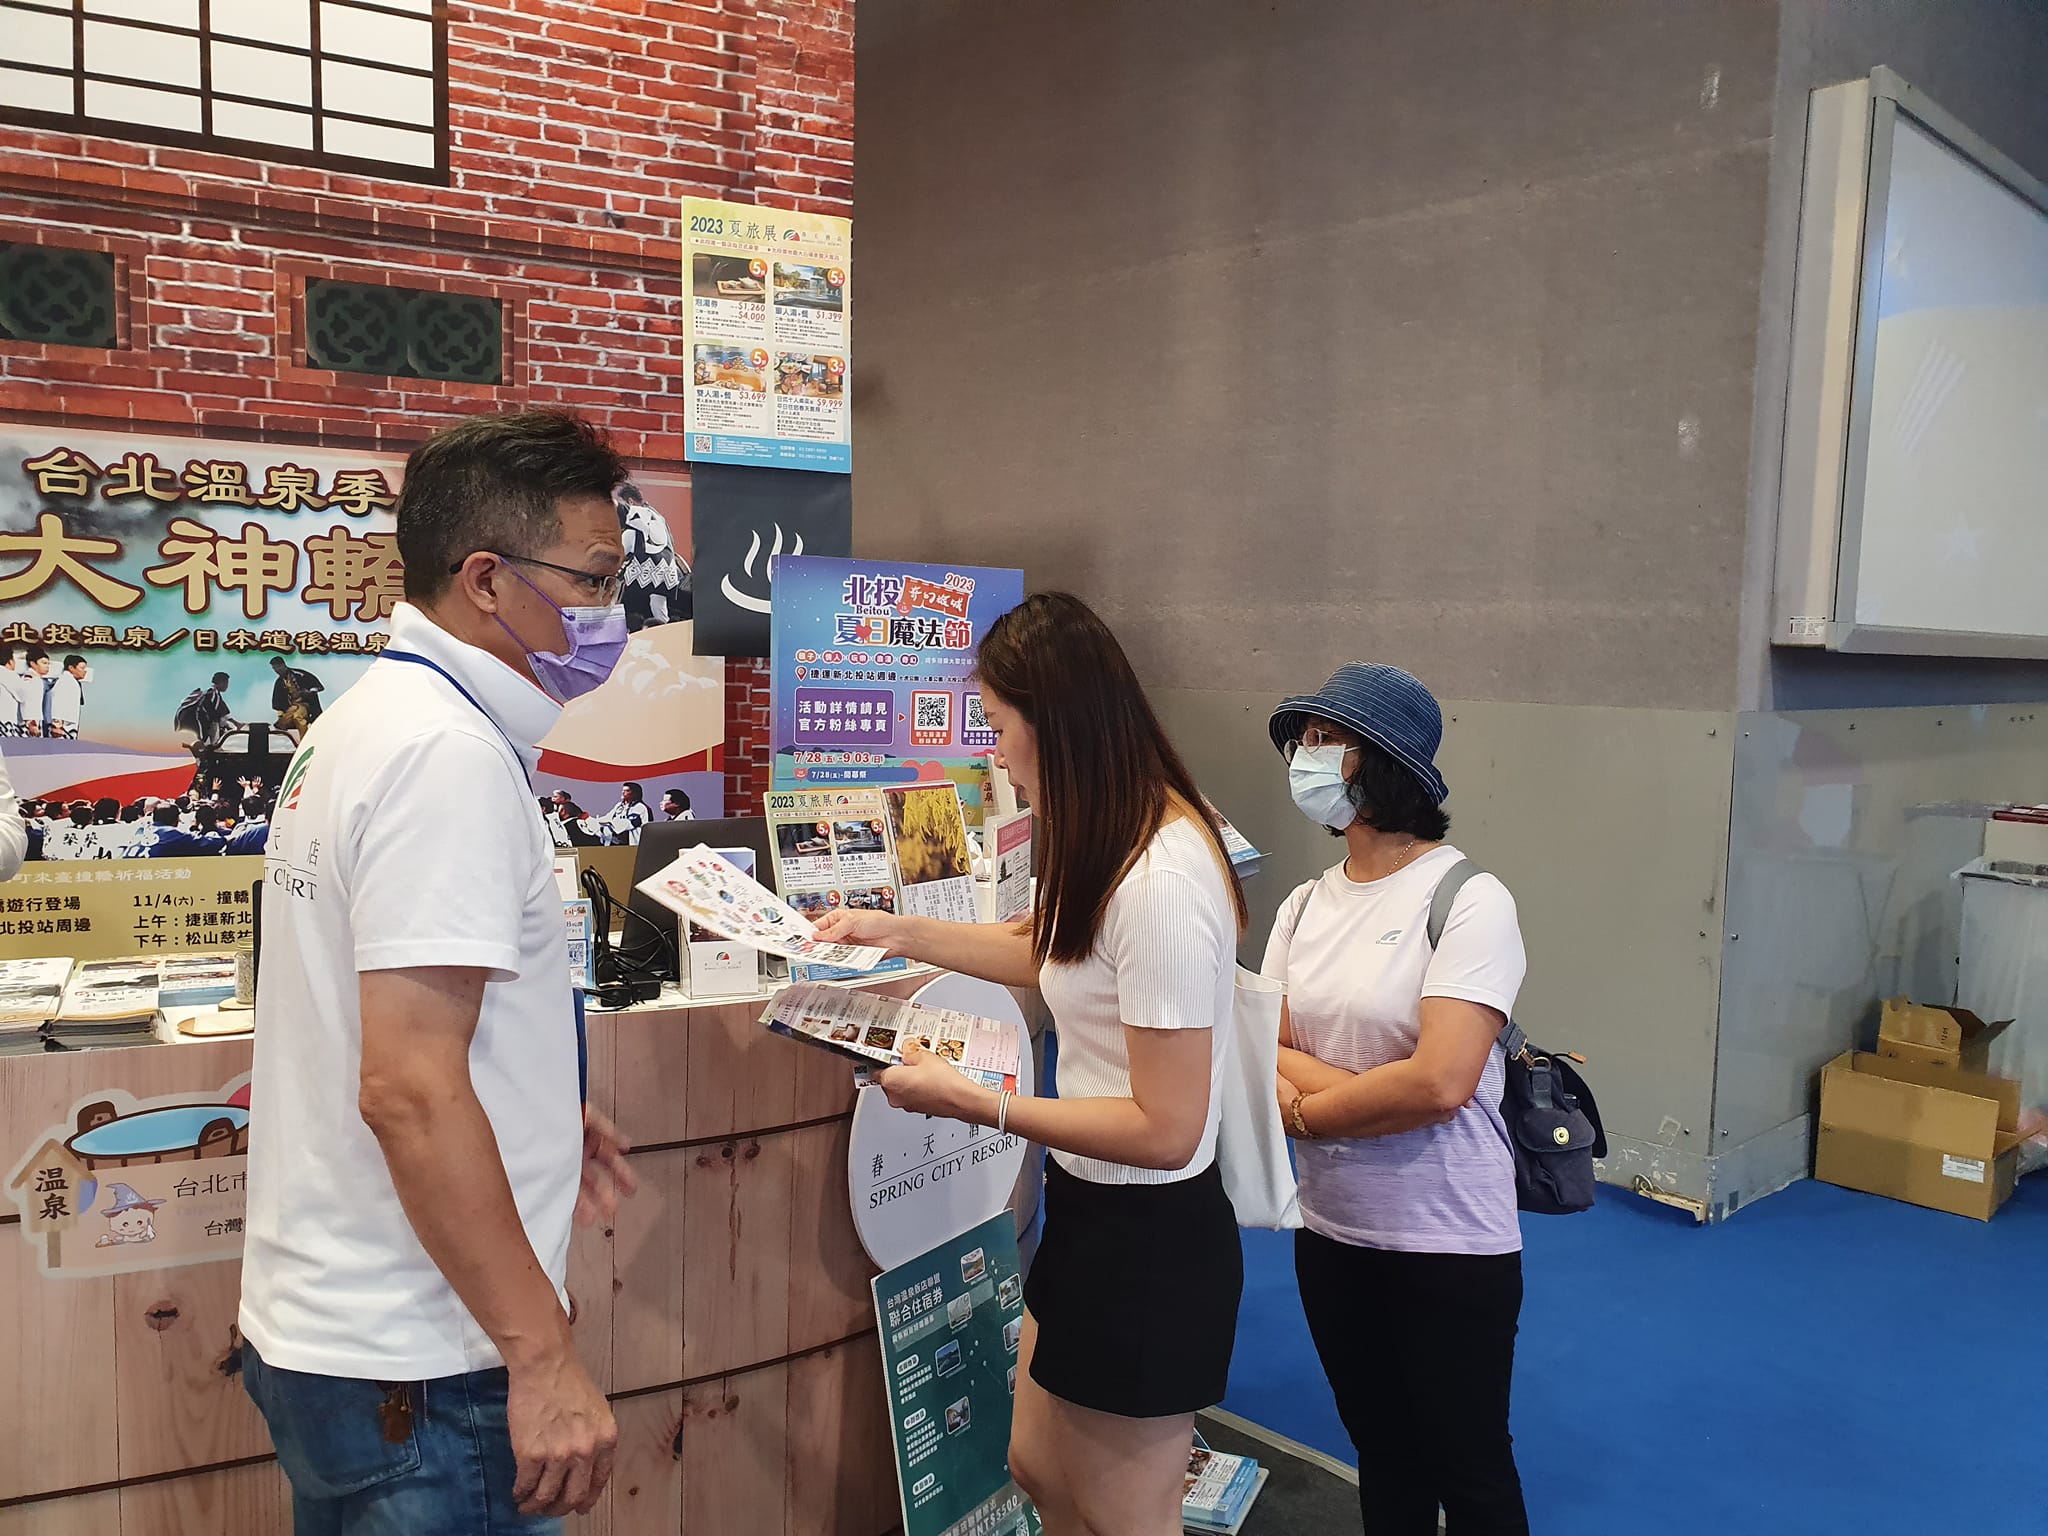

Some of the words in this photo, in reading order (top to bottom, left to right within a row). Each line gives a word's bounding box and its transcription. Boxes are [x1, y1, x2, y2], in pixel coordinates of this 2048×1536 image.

[690, 216, 724, 235] 2023
[728, 219, 778, 242] 夏旅展
[738, 302, 766, 312] $1,260
[738, 311, 766, 321] $4,000
[816, 311, 843, 321] $1,399
[738, 391, 767, 401] $3,699
[816, 398, 843, 408] $9,999
[24, 447, 397, 517] 台北溫泉季
[0, 512, 404, 620] 大神轎
[843, 575, 900, 606] 北投
[945, 574, 974, 591] 2023
[855, 604, 890, 616] Beitou
[835, 615, 971, 649] 夏日魔法節
[798, 701, 888, 716] 活動詳情請見
[798, 718, 888, 732] 官方粉絲專頁
[771, 796, 795, 808] 2023
[799, 794, 833, 808] 夏旅展
[133, 893, 194, 908] 11/4(六)
[217, 890, 250, 905] 撞轎
[173, 1171, 247, 1198] 台北市
[869, 1173, 924, 1209] SPRING
[931, 1156, 965, 1182] CITY
